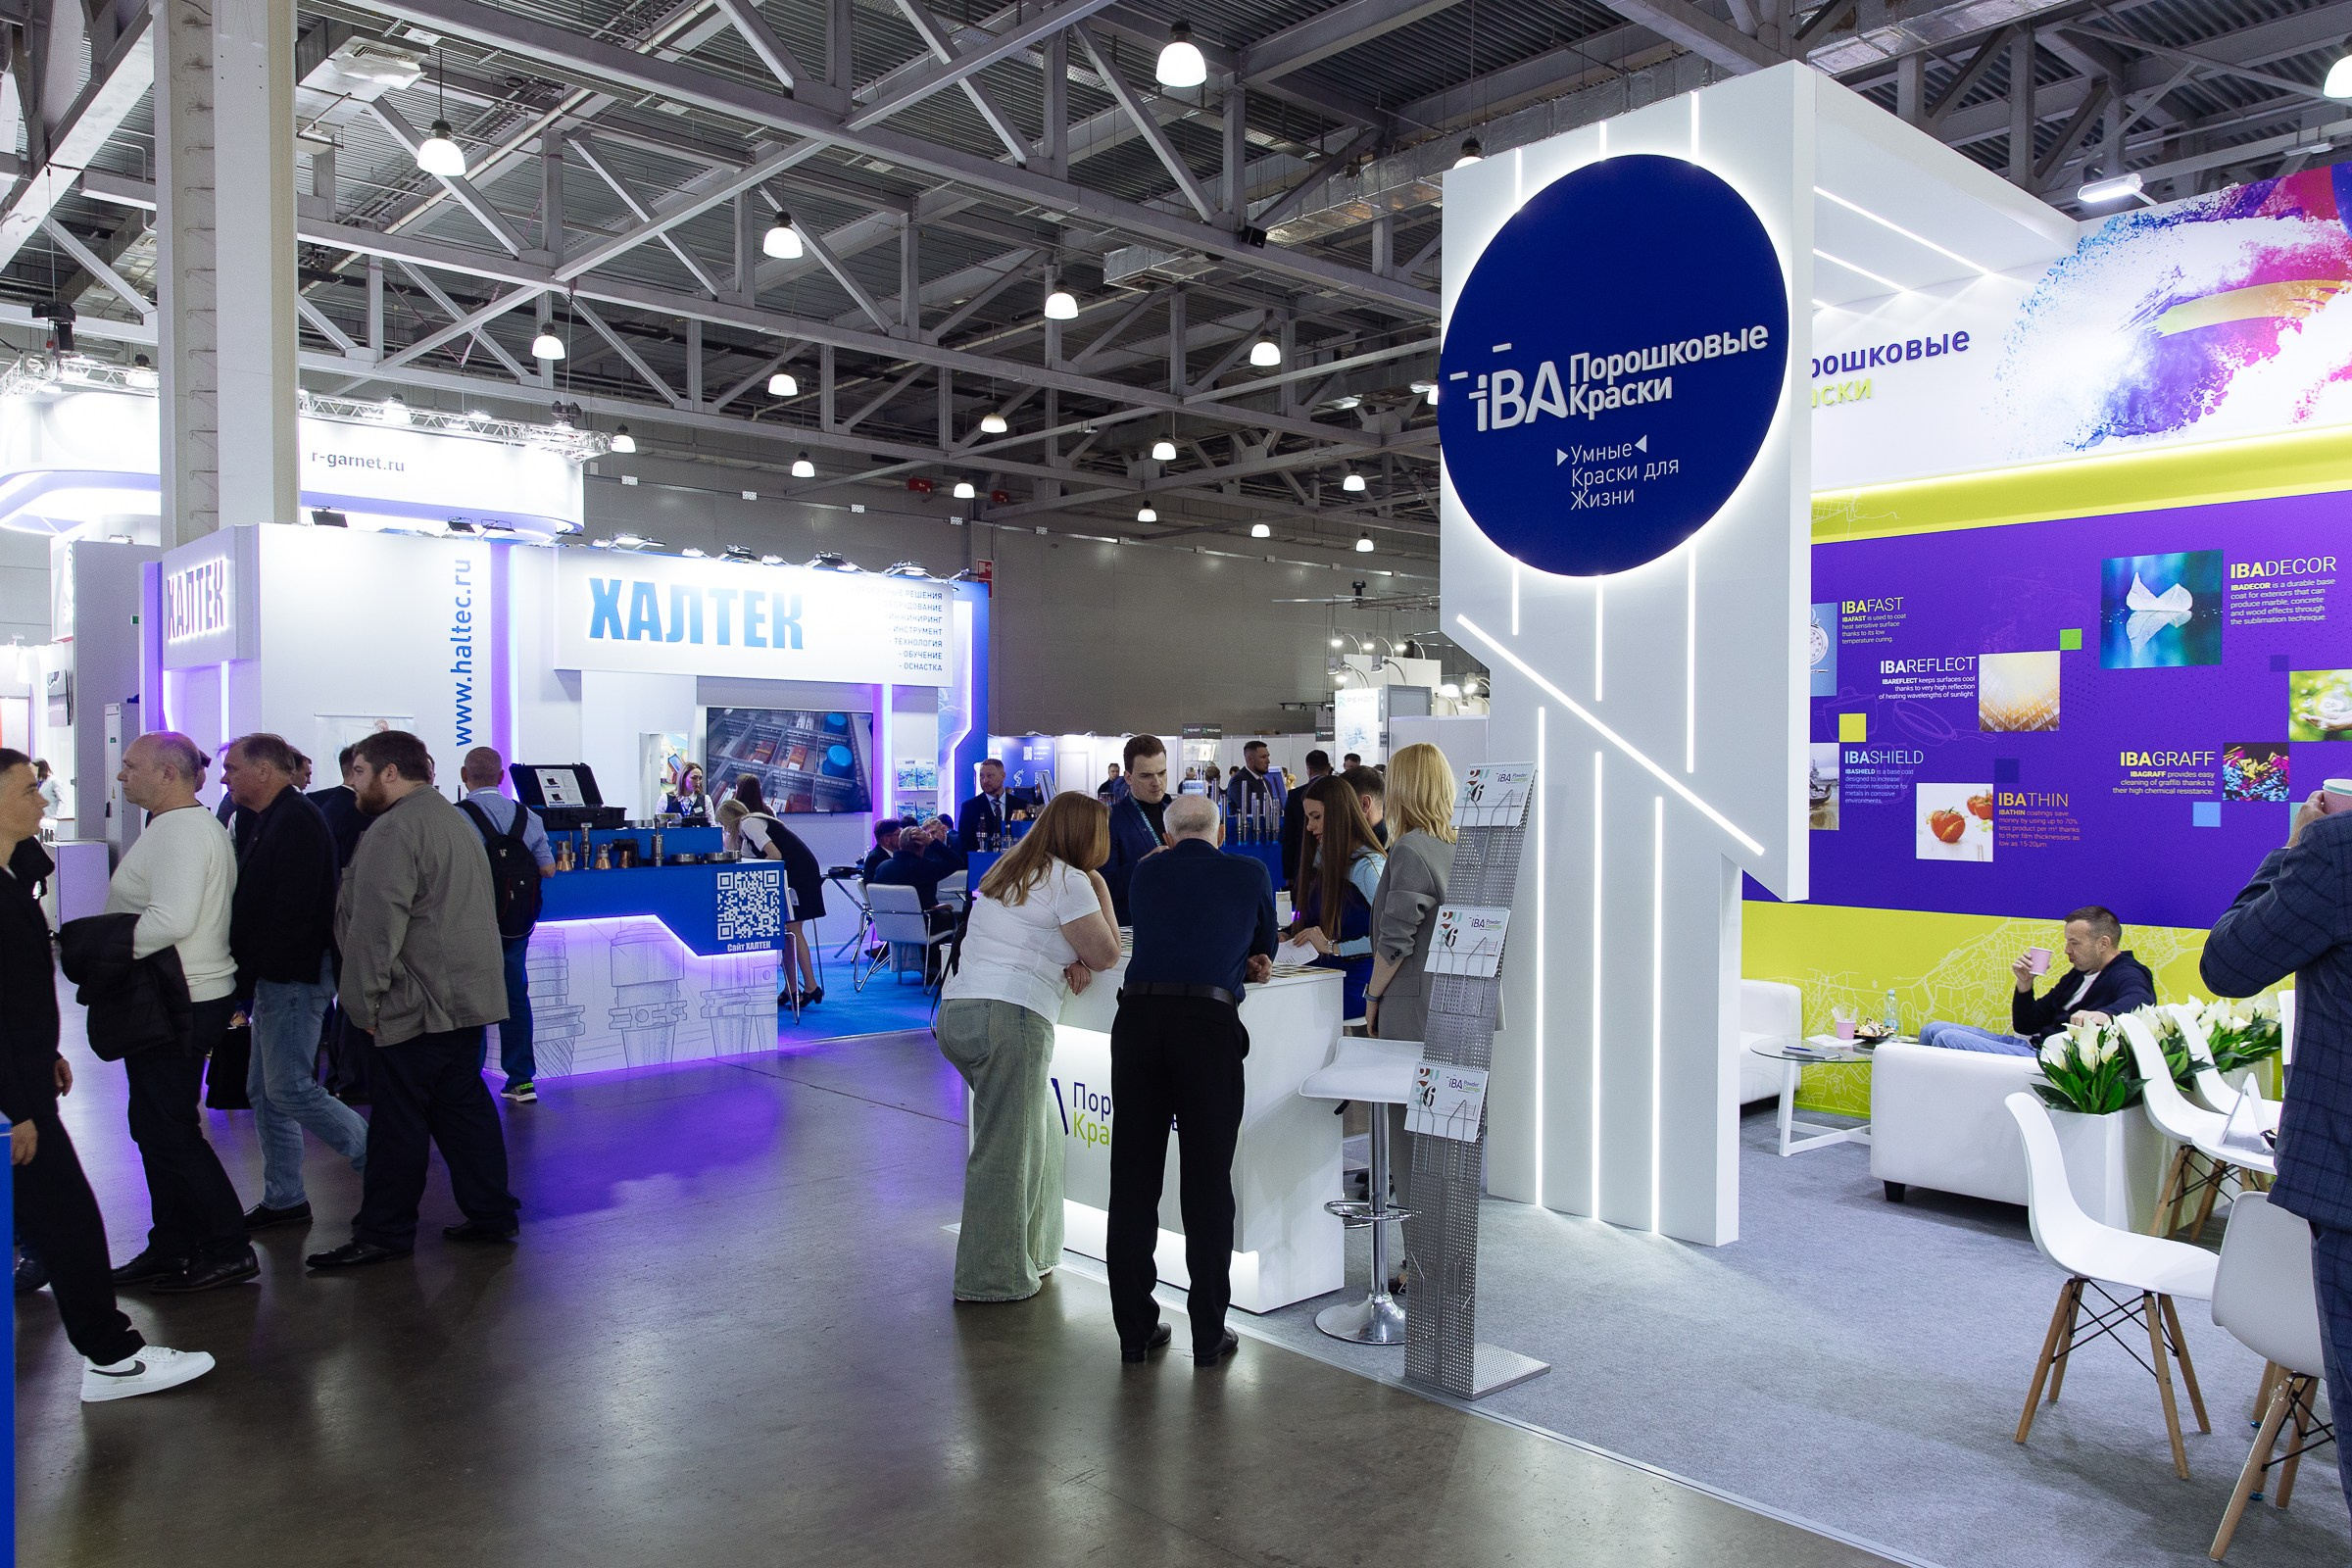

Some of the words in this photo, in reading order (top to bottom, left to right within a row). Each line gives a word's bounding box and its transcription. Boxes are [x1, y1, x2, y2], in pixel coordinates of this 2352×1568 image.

[1571, 325, 1769, 385] Порошковые
[1570, 376, 1673, 420] Краски
[313, 452, 404, 471] r-garnet.ru
[1571, 440, 1633, 466] Умные
[1572, 464, 1638, 490] Краски
[1643, 459, 1680, 481] для
[1571, 489, 1635, 511] Жизни
[2230, 556, 2336, 579] IBADECOR
[168, 560, 223, 640] ХАЛТЕК
[906, 590, 942, 599] РЕШЕНИЯ
[589, 578, 803, 649] ХАЛТЕК
[1842, 597, 1903, 613] IBAFAST
[894, 626, 942, 635] ИНСТРУМЕНТ
[895, 638, 942, 647] ТЕХНОЛОГИЯ
[450, 560, 471, 746] www.haltec.ru
[1881, 657, 1976, 673] IBAREFLECT
[1844, 751, 1924, 764] IBASHIELD
[2121, 752, 2216, 766] IBAGRAFF
[1998, 793, 2068, 807] IBATHIN
[727, 943, 745, 952] Сайт
[746, 941, 770, 951] ХАЛТЕК
